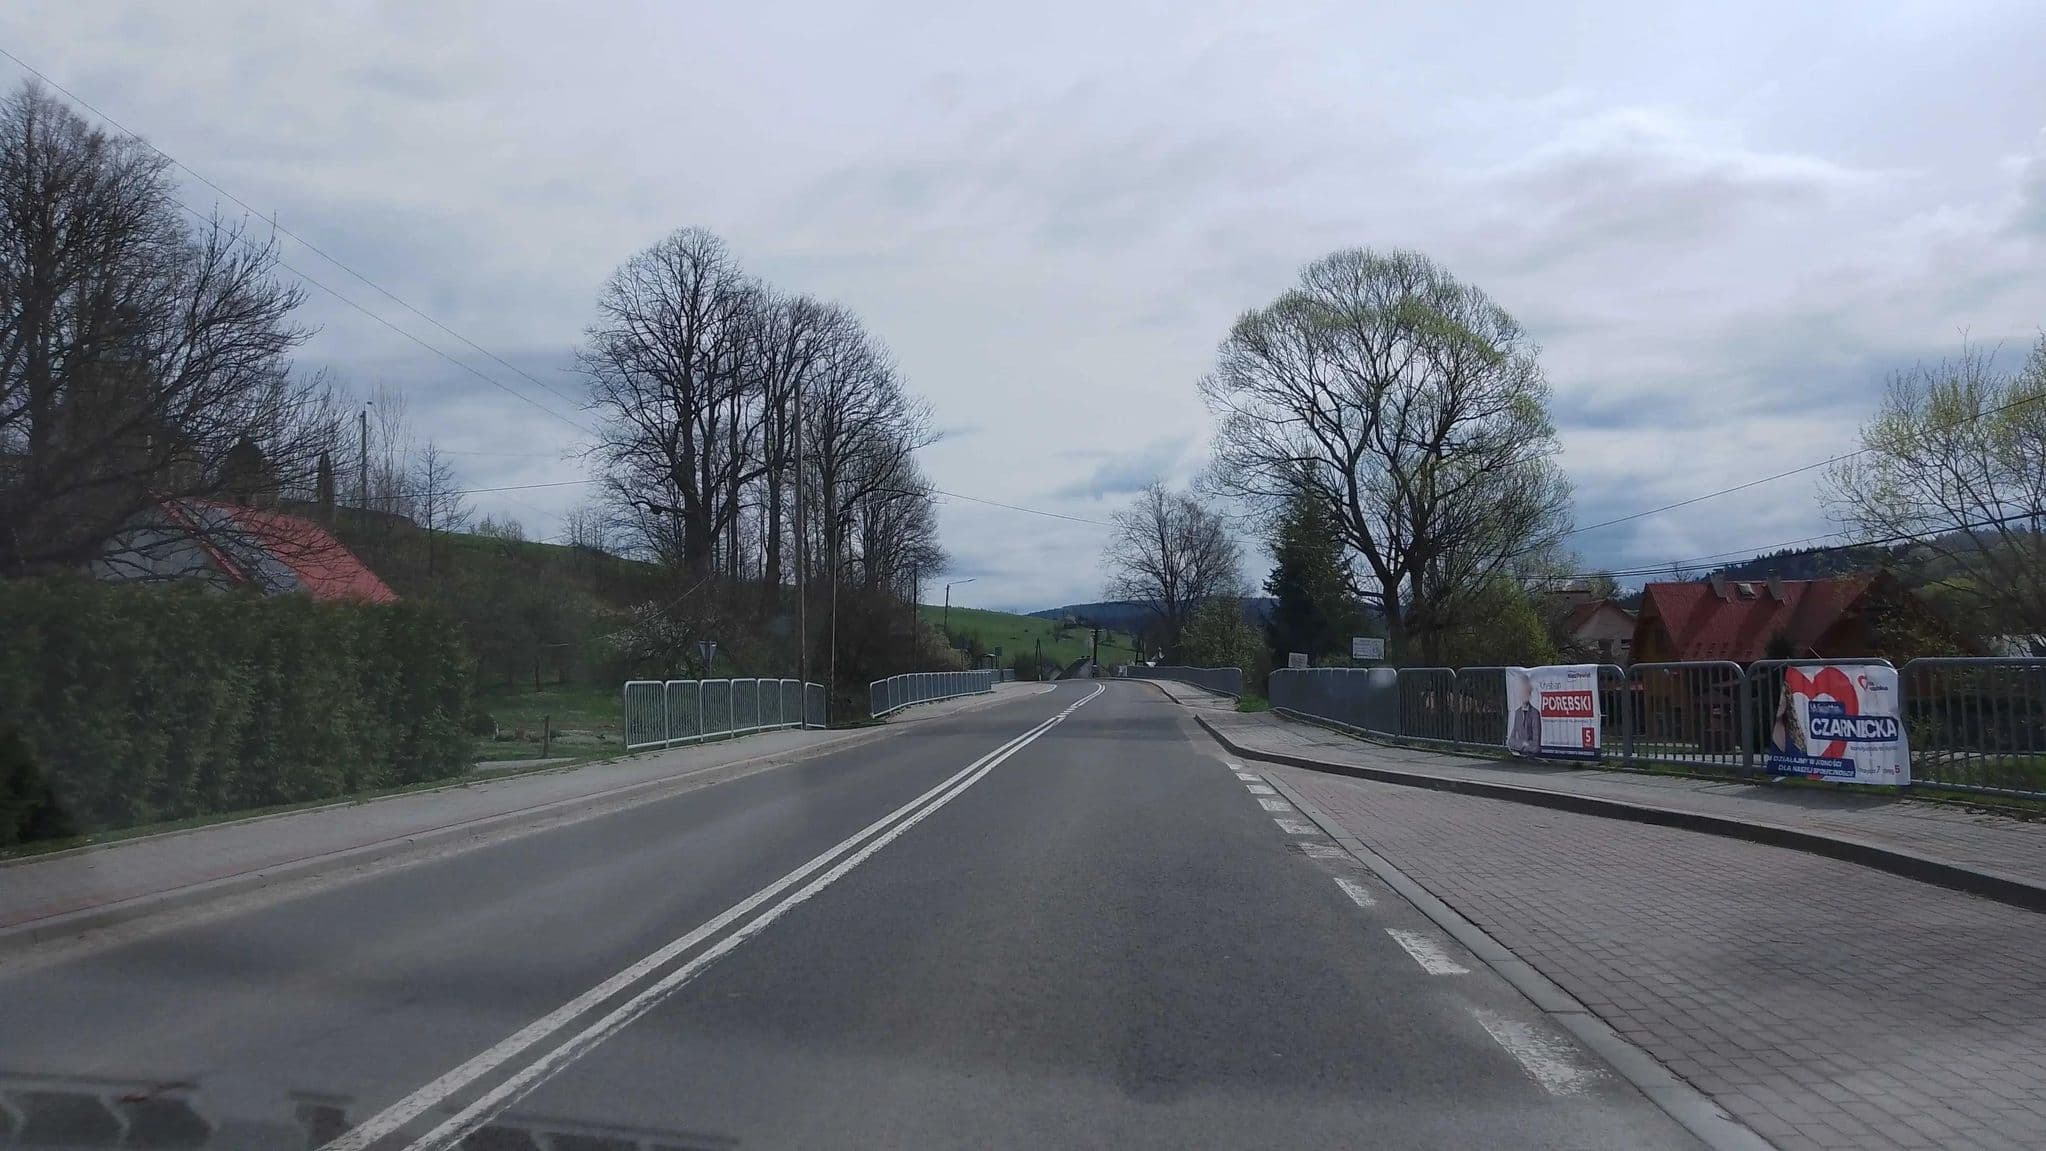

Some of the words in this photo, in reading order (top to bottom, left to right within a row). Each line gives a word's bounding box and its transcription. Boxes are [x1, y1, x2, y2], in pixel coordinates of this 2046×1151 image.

[1542, 695, 1592, 715] PORĘBSKI
[1585, 730, 1591, 742] 5
[1894, 764, 1900, 774] 5
